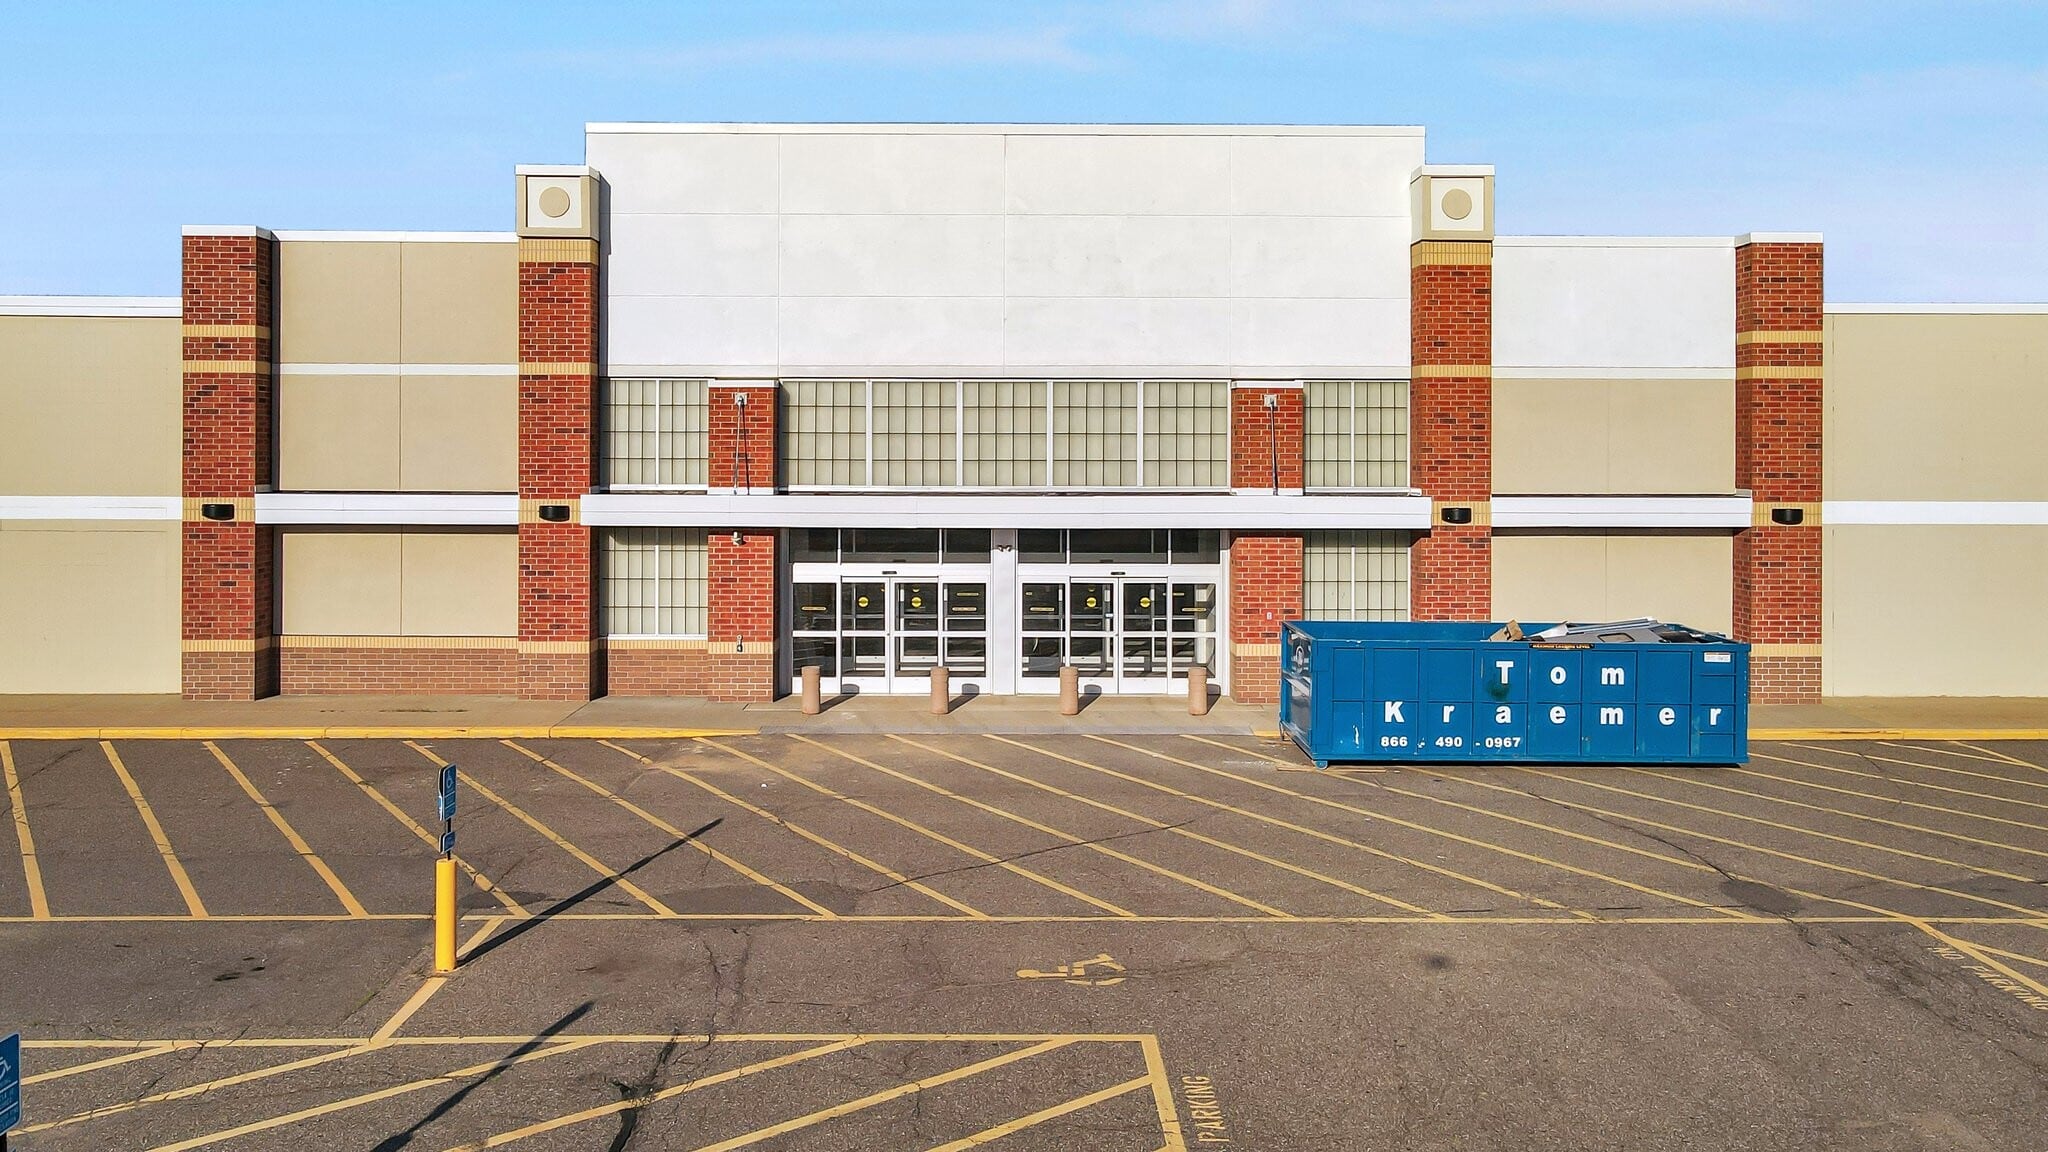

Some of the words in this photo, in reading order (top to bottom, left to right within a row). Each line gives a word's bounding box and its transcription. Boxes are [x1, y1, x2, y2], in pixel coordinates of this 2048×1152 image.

[1496, 660, 1625, 685] Tom
[1384, 701, 1722, 726] Kraemer
[1380, 736, 1408, 747] 866
[1435, 736, 1463, 747] 490
[1485, 737, 1521, 748] 0967
[1181, 1075, 1230, 1142] PARKING
